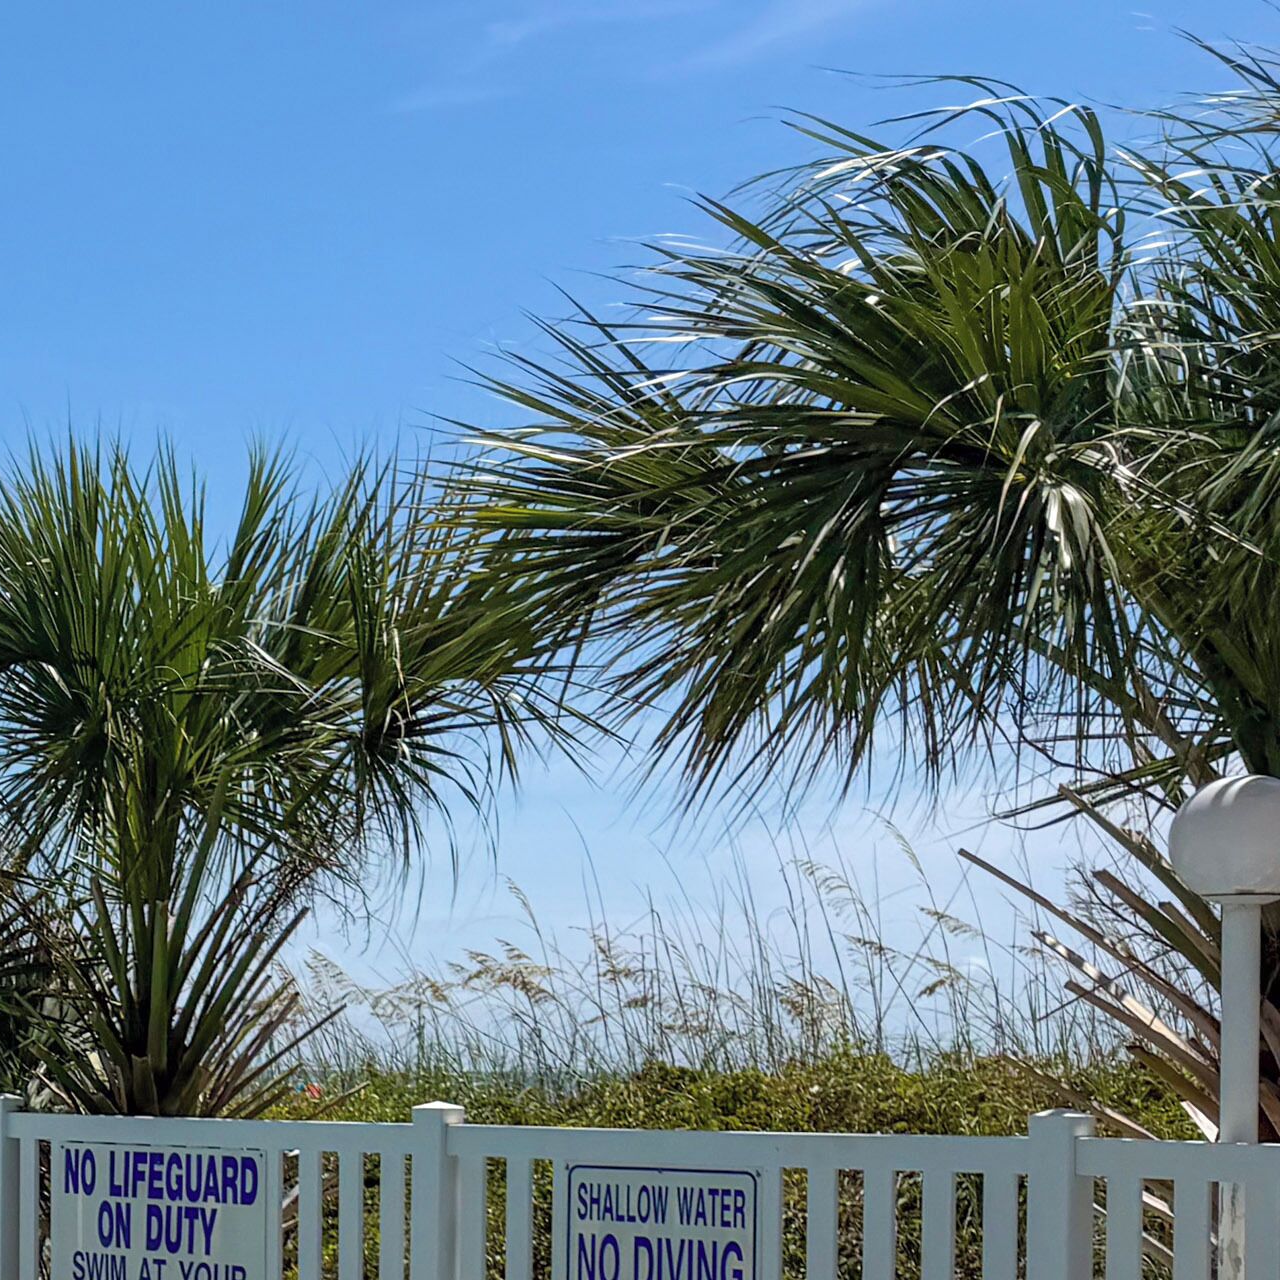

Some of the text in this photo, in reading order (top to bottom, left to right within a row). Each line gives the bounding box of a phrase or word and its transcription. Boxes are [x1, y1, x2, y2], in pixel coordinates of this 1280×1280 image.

[65, 1149, 258, 1206] NO LIFEGUARD
[577, 1182, 746, 1229] SHALLOW WATER
[98, 1200, 217, 1256] ON DUTY
